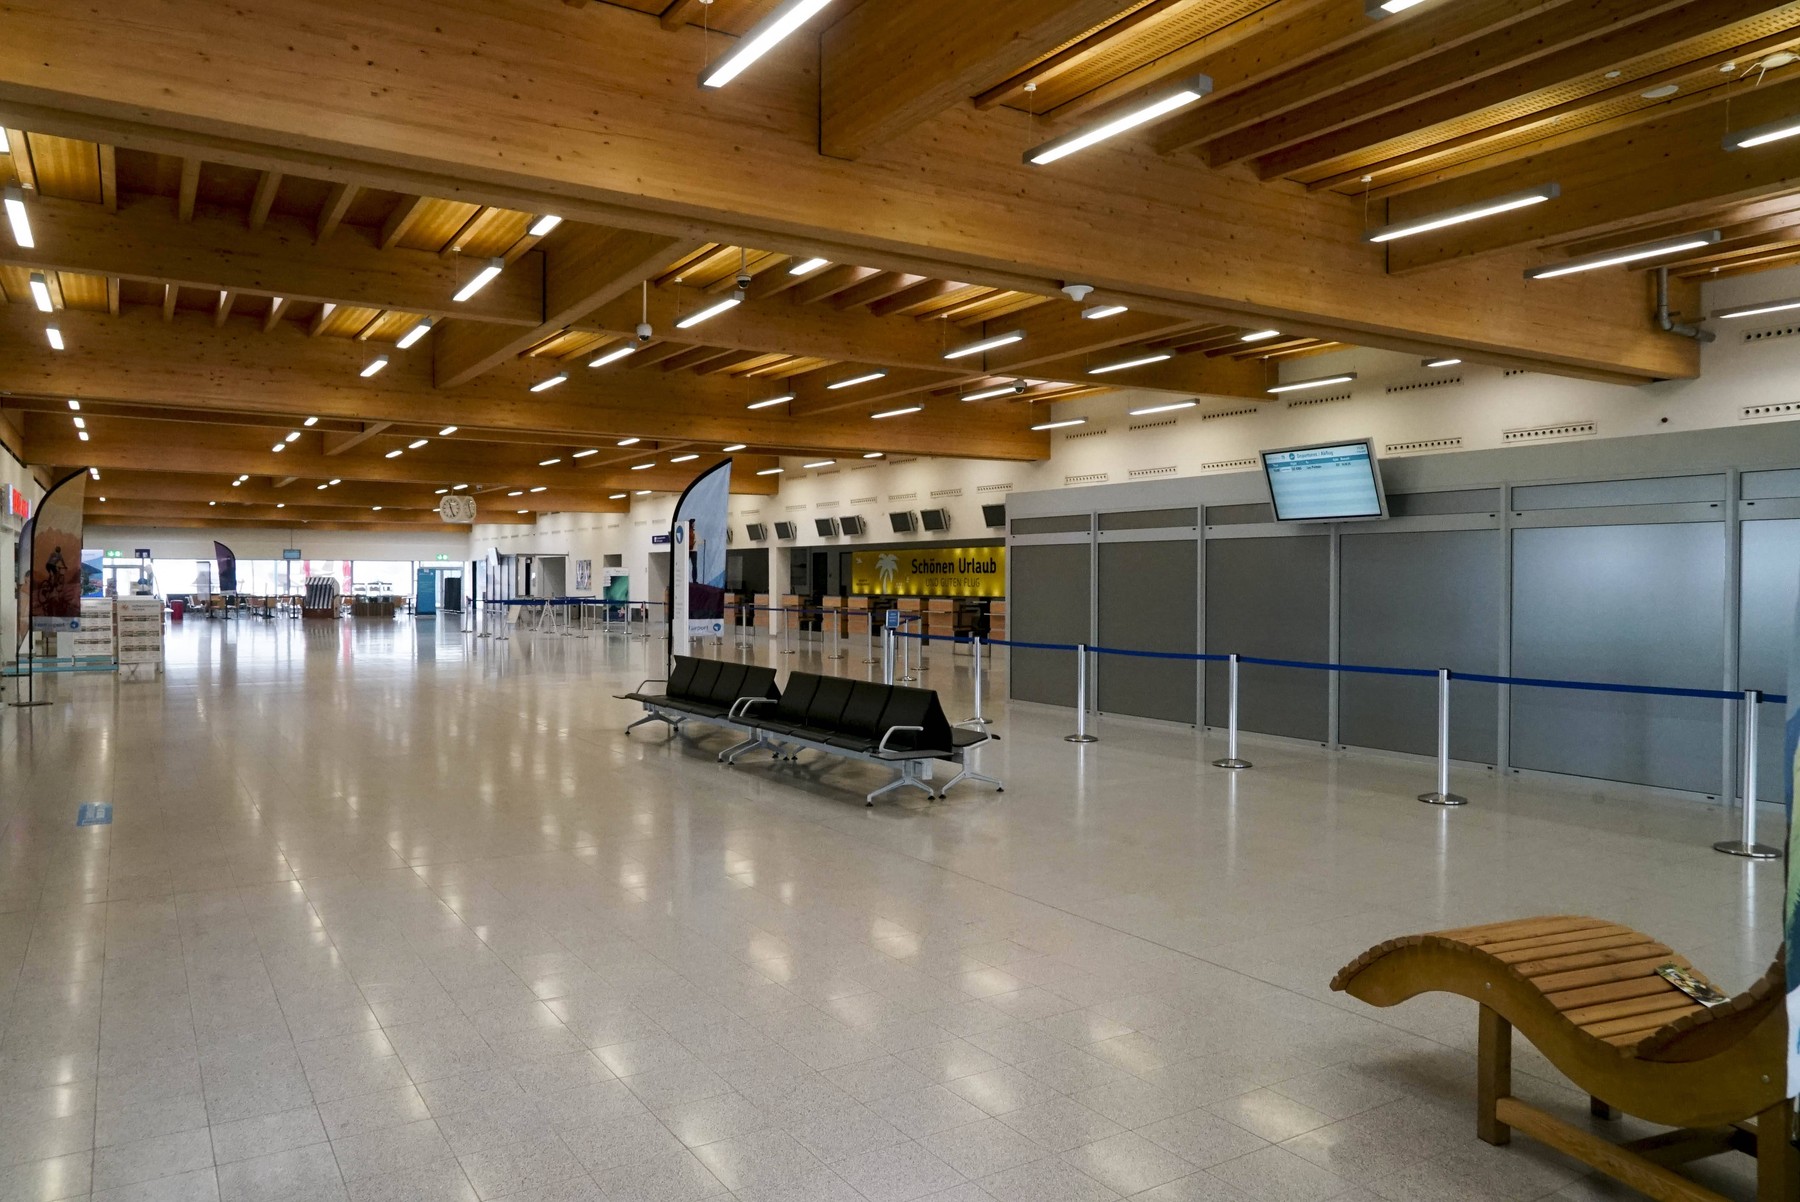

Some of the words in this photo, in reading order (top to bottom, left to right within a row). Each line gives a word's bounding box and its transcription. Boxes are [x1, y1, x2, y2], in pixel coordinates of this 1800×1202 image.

[912, 558, 954, 574] Schönen
[958, 557, 996, 574] Urlaub
[925, 578, 938, 587] UND
[940, 578, 961, 587] GUTEN
[963, 577, 981, 588] FLUG
